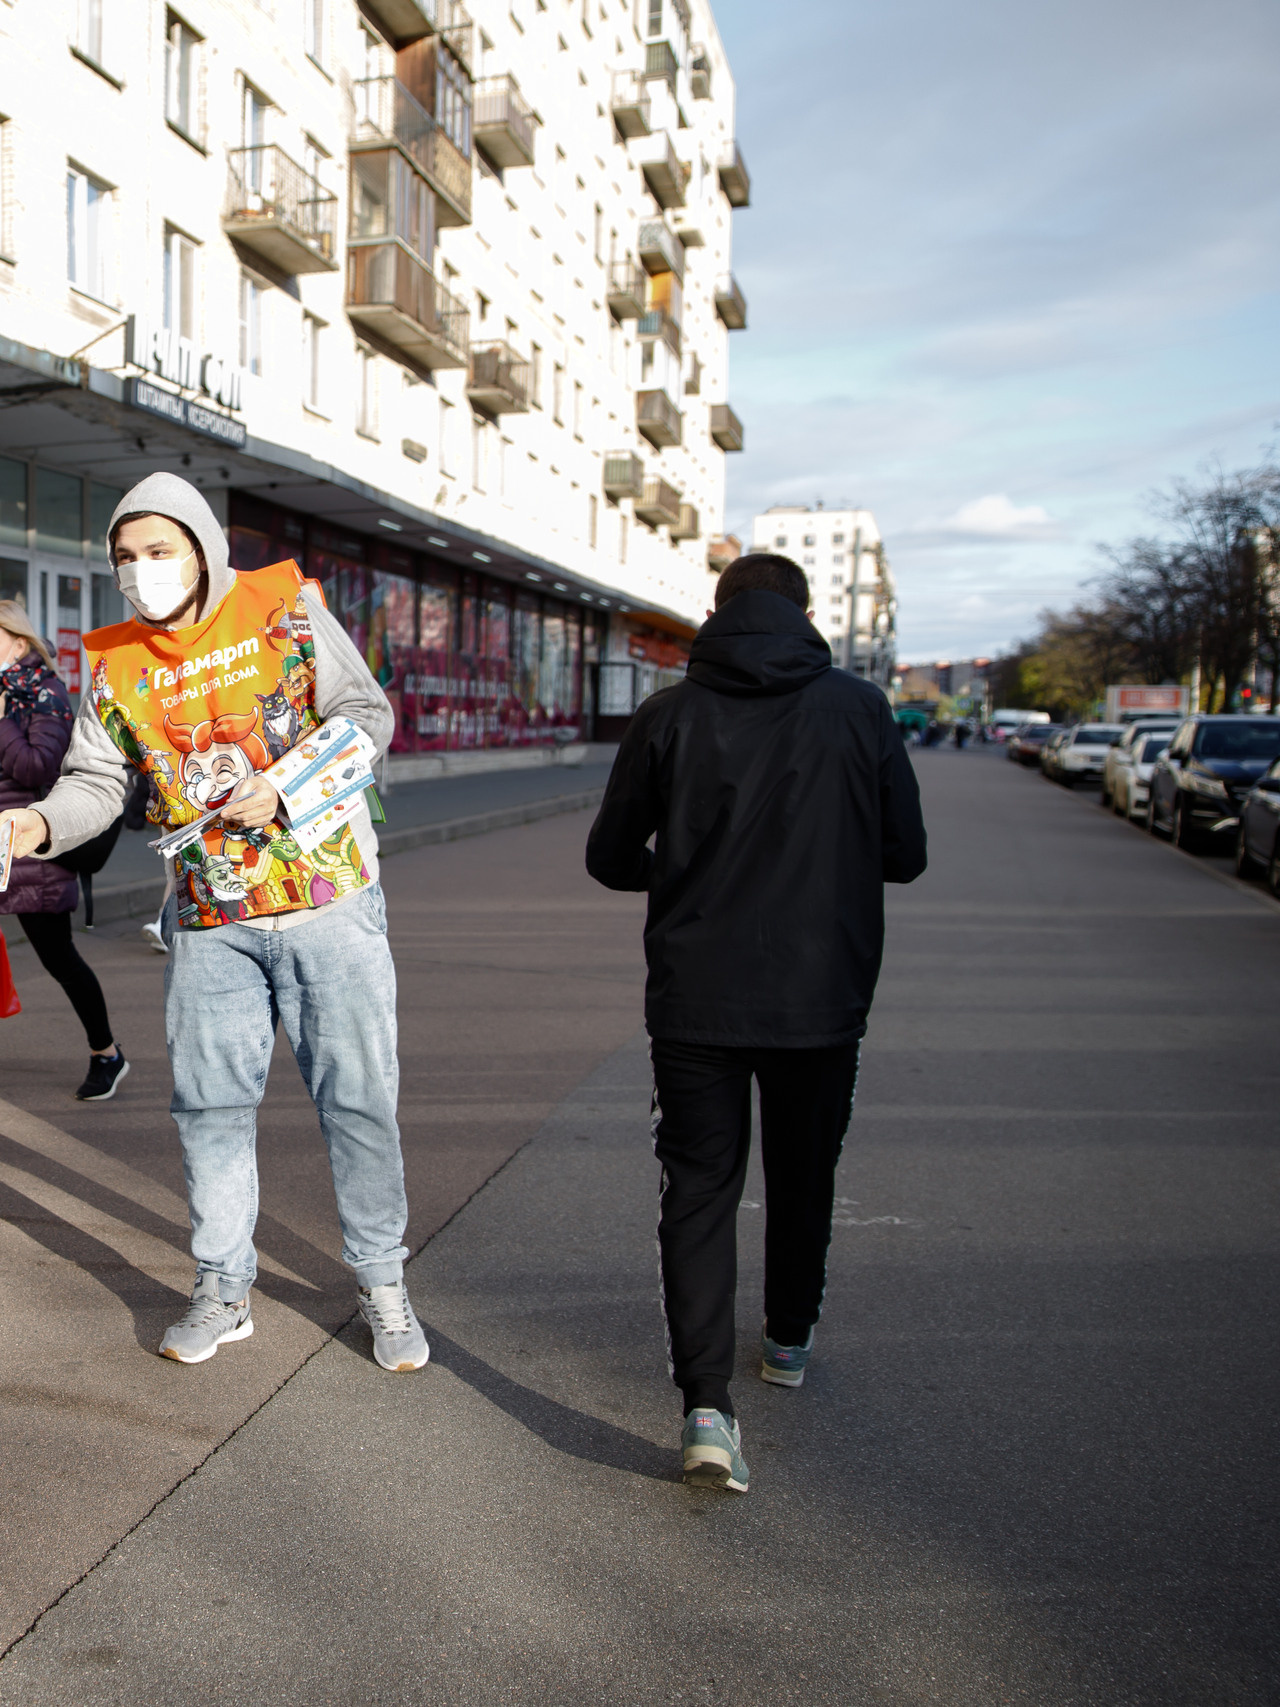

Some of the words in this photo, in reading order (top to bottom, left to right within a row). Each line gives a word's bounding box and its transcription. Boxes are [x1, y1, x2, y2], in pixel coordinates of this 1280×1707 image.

[154, 637, 260, 690] Галамарт
[160, 686, 199, 710] ТОВАРЫ
[201, 677, 221, 696] ДЛЯ
[223, 665, 260, 688] ДОМА
